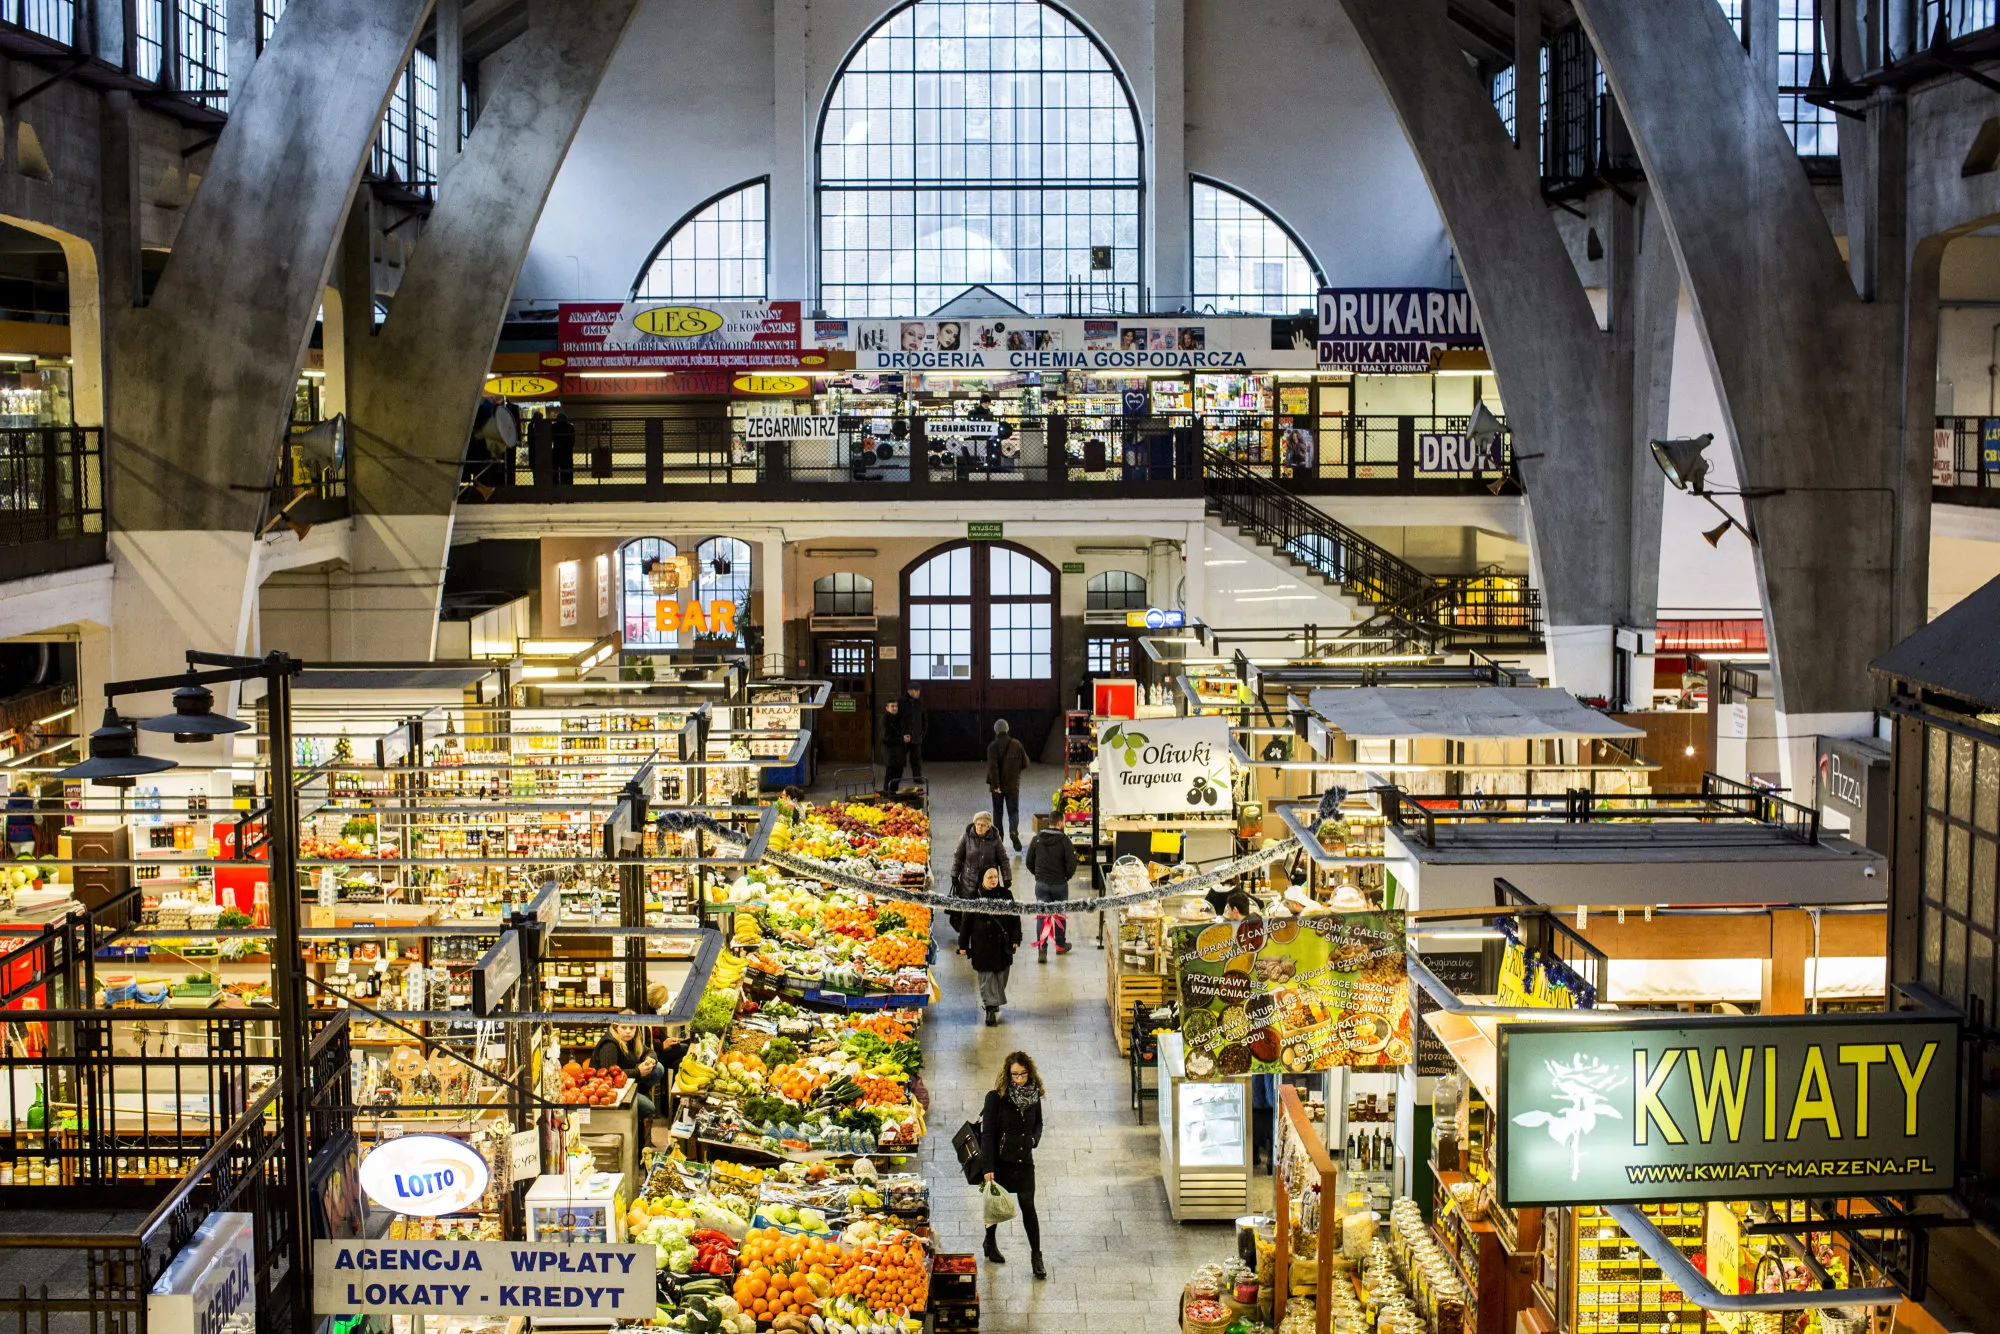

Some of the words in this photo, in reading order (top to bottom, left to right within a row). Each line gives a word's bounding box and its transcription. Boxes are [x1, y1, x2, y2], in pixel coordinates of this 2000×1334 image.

[651, 311, 707, 332] LES
[740, 309, 782, 320] TKANINY
[727, 322, 796, 333] DEKORACYJNE
[878, 352, 985, 368] DROGERIA
[1010, 351, 1088, 367] CHEMIA
[1094, 351, 1247, 367] GOSPODARCZA
[1320, 342, 1429, 363] DRUKARNIA
[1320, 364, 1353, 372] WIELKI
[1361, 364, 1388, 372] MAŁY
[1390, 364, 1428, 372] FORMAT
[498, 377, 545, 392] LES
[566, 377, 638, 393] STOISKO
[646, 374, 726, 391] FIRMOWE
[748, 376, 794, 391] LES
[748, 417, 836, 438] ZEGARMISTRZ
[930, 424, 993, 433] ZEGARMISTRZ
[970, 523, 1001, 531] WYJŚCIE
[655, 599, 737, 632] BAR
[1143, 741, 1212, 767] Oliwki
[1119, 771, 1182, 788] Targowa
[1297, 919, 1344, 933] ORZECHY
[1344, 926, 1352, 934] Z
[1353, 927, 1394, 941] CAŁEGO
[1180, 937, 1238, 963] PRZYPRAWY
[1239, 933, 1247, 942] Z
[1247, 920, 1287, 939] CAŁEGO
[1293, 967, 1326, 983] OWOCE
[1327, 961, 1335, 971] W
[1337, 945, 1397, 968] CZEKOLADZIE
[1187, 973, 1248, 987] PRZYPRAWY
[1249, 980, 1268, 991] BEZ
[1191, 985, 1261, 1000] WZMACNIACZY
[1318, 978, 1351, 989] OWOCE
[1353, 982, 1395, 994] SUSZONE
[1188, 1017, 1244, 1047] PRZYPRAWY
[1240, 1032, 1265, 1047] SODU
[1280, 1033, 1315, 1047] OWOCE
[1315, 1016, 1372, 1036] NATURALNIE
[1298, 1034, 1338, 1053] SUSZONE
[1339, 1029, 1359, 1040] BEZ
[1203, 1037, 1223, 1052] BEZ
[1293, 1045, 1335, 1065] DODATKU
[1337, 1038, 1370, 1051] CUKRU
[1633, 1041, 1940, 1146] KWIATY
[1625, 1156, 1936, 1184] WWW.KWIATY-MARZENA.PL
[395, 1169, 455, 1198] LOTTO
[335, 1249, 483, 1271] AGENCJA
[511, 1251, 637, 1273] WPŁATY
[347, 1284, 471, 1306] LOKATY
[500, 1286, 625, 1309] KREDYT
